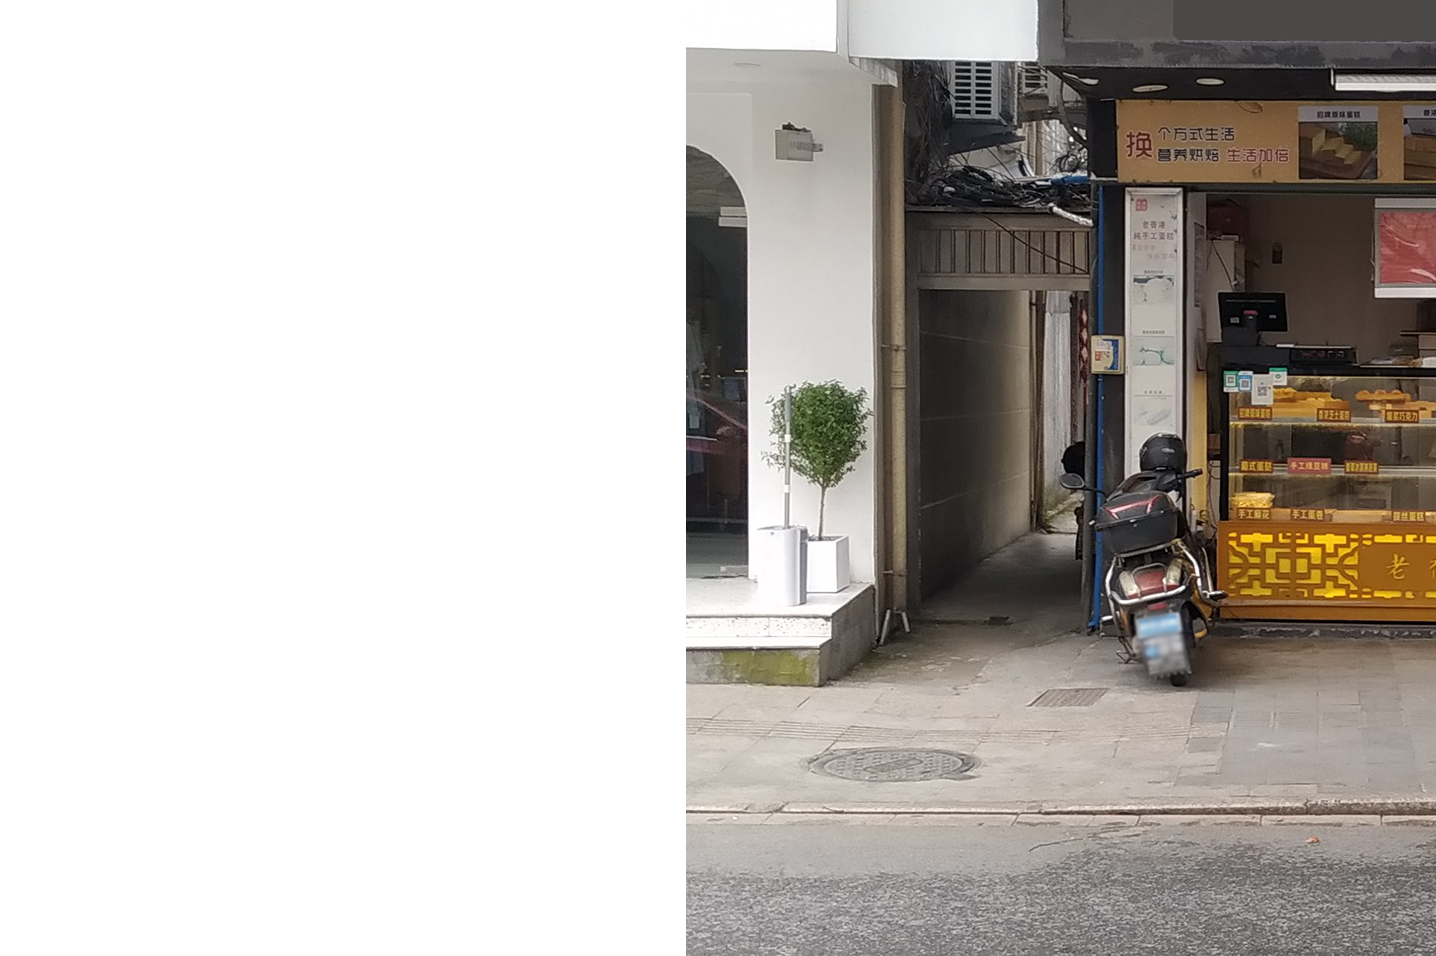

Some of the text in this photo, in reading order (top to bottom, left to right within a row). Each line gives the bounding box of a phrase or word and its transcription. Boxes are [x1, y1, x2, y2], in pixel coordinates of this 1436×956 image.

[1157, 127, 1235, 142] 个方式生活
[1126, 131, 1152, 158] 换
[1157, 148, 1289, 162] 营养烘焙 生活加倍
[1238, 508, 1270, 519] 手工麻花
